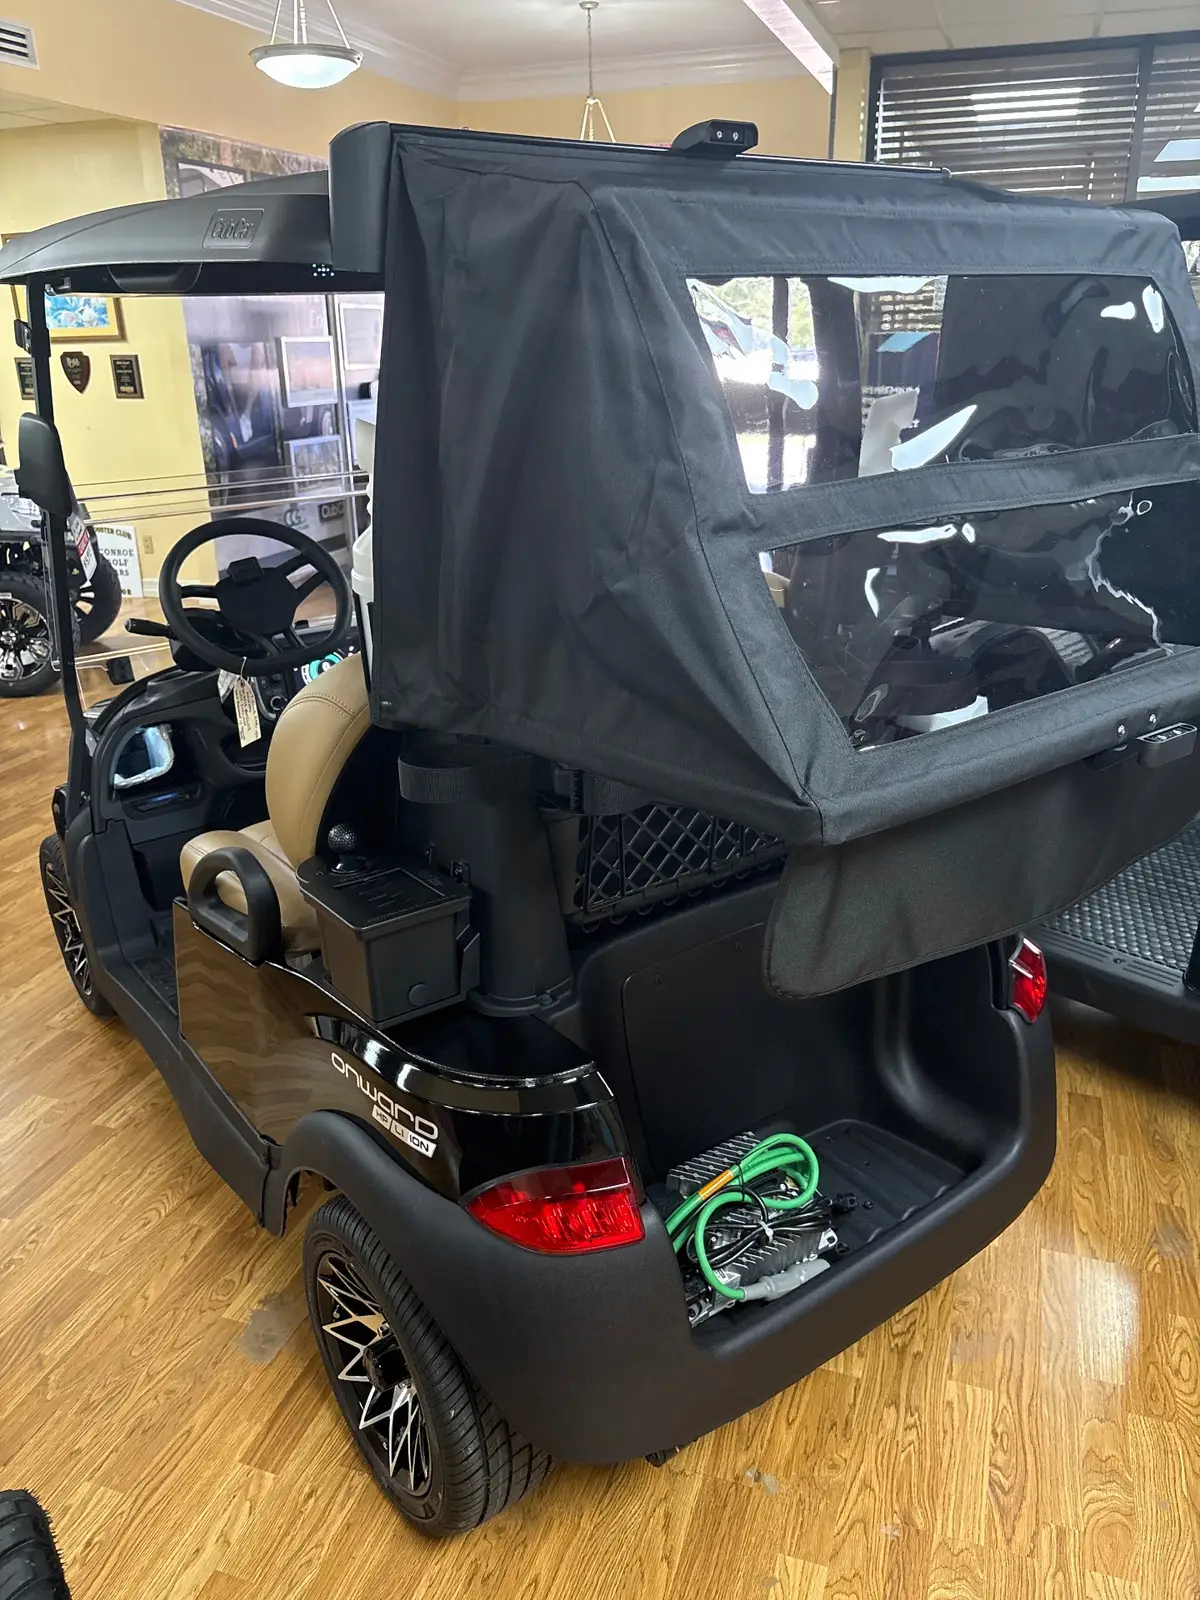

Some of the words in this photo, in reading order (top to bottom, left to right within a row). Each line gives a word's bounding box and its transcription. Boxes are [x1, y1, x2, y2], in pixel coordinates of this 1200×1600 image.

[95, 527, 114, 535] OSTER
[115, 529, 132, 540] CLUB
[109, 558, 129, 567] OLF
